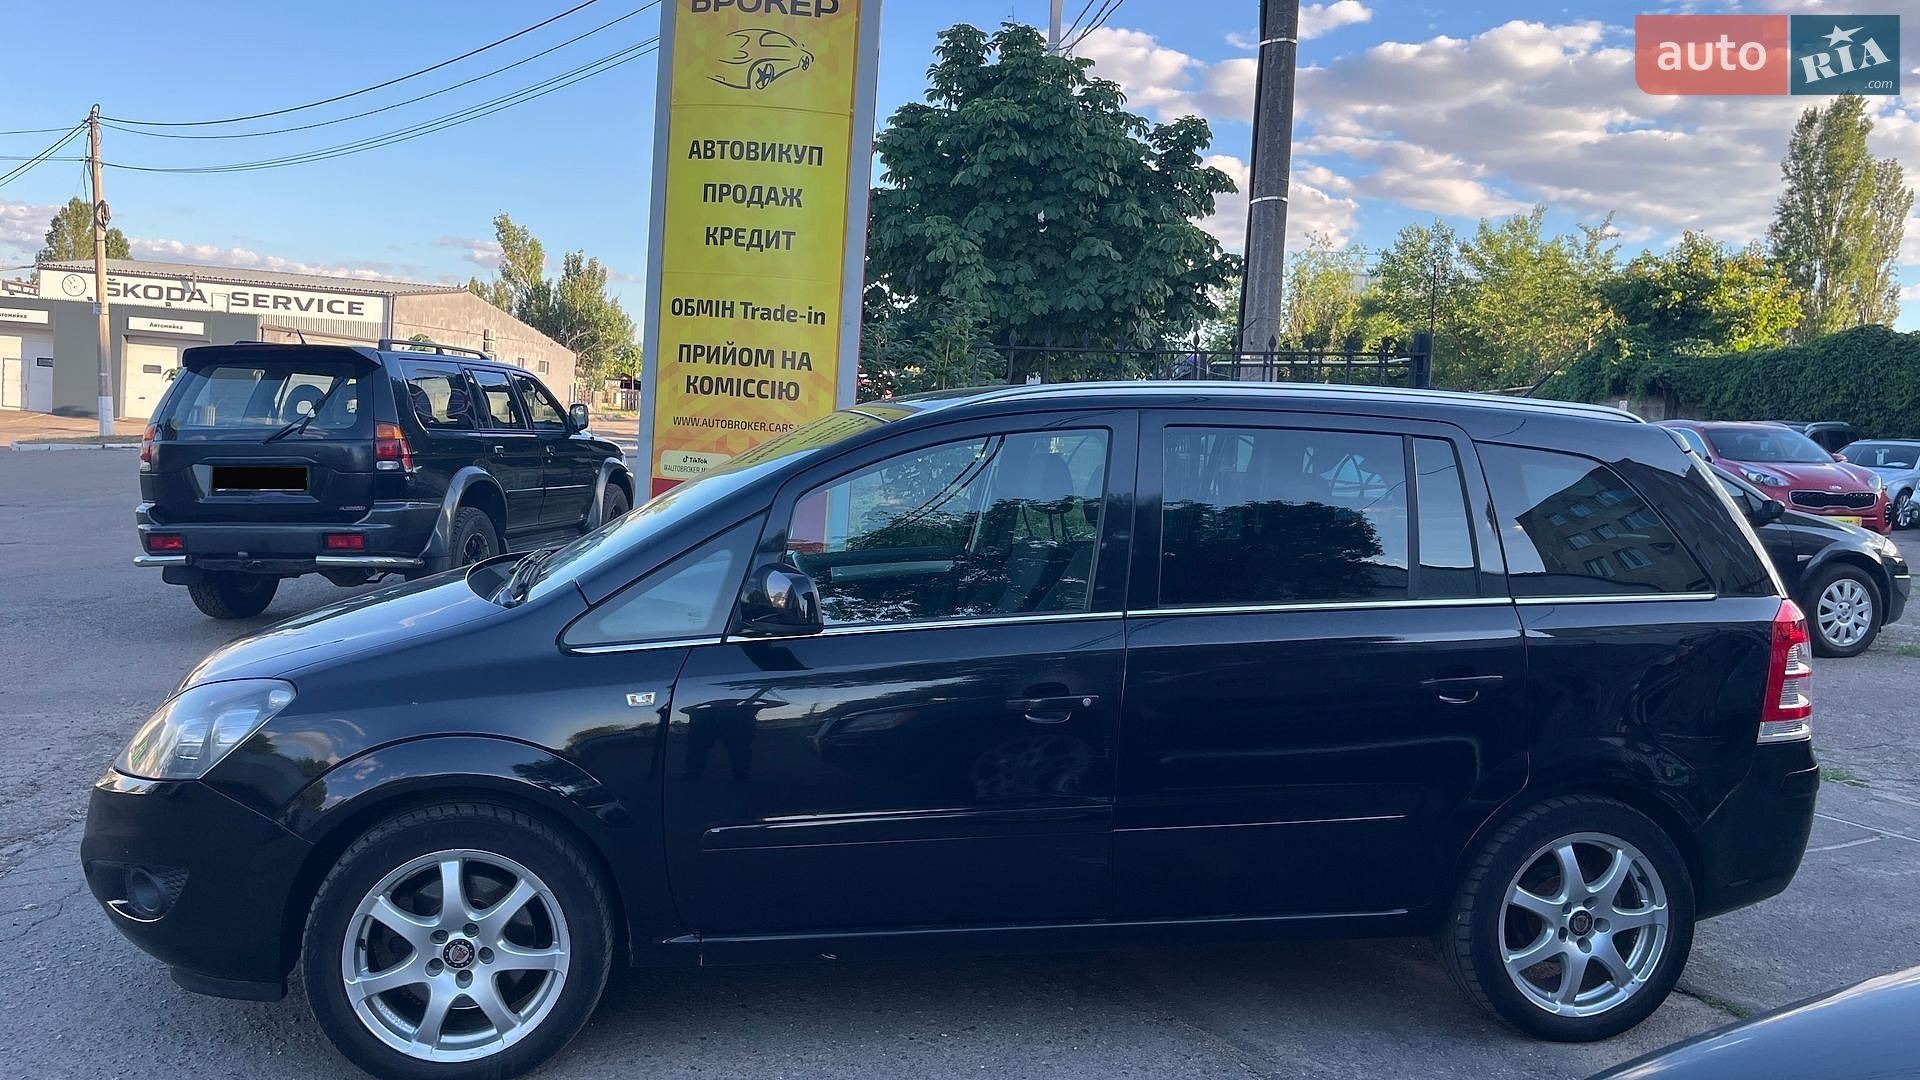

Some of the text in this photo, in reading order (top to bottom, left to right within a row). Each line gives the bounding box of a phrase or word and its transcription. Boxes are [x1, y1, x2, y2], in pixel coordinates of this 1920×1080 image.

[688, 140, 823, 166] АВТОВИКУП
[703, 183, 803, 209] ПРОДАЖ
[705, 226, 796, 252] КРЕДИТ
[231, 291, 365, 316] SERVICE
[671, 297, 826, 326] ОБМІН Trade-in
[678, 341, 813, 372] ПРИЙОМ НА
[685, 375, 800, 401] КОМІССІЮ
[673, 416, 799, 432] WWW.AUTOBROKER.CARS
